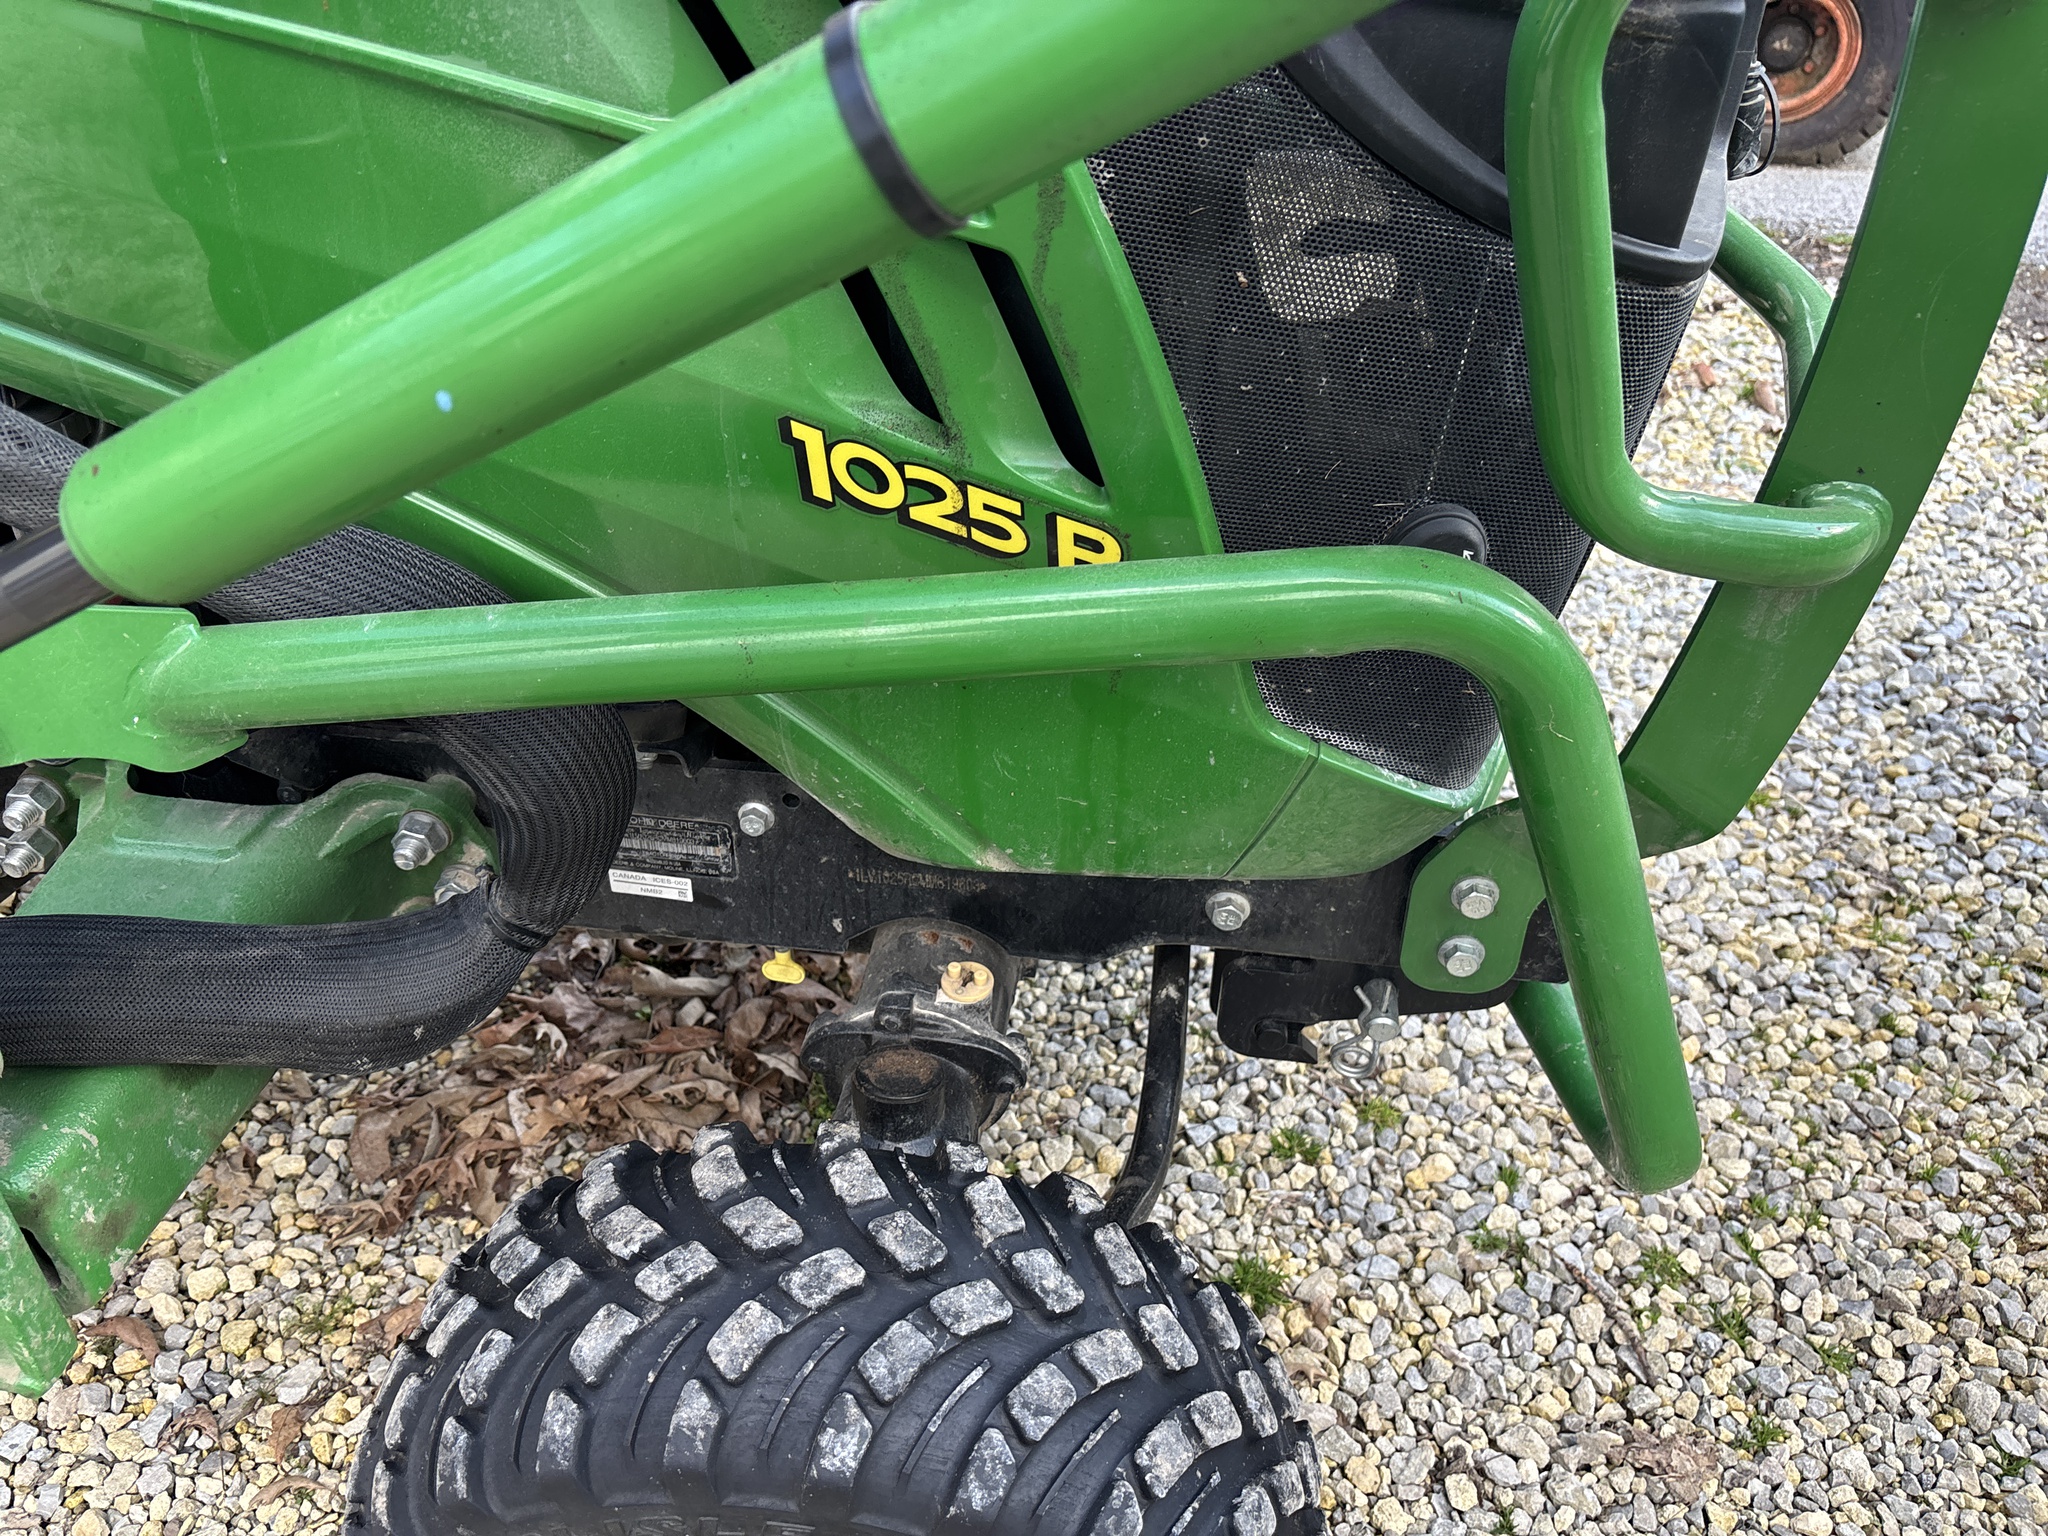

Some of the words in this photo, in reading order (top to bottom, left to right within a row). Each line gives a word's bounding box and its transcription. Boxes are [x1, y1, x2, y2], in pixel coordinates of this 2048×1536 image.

[781, 417, 1029, 557] 1025
[629, 816, 655, 827] OHN
[658, 819, 695, 830] DEERE
[612, 872, 647, 881] CANADA
